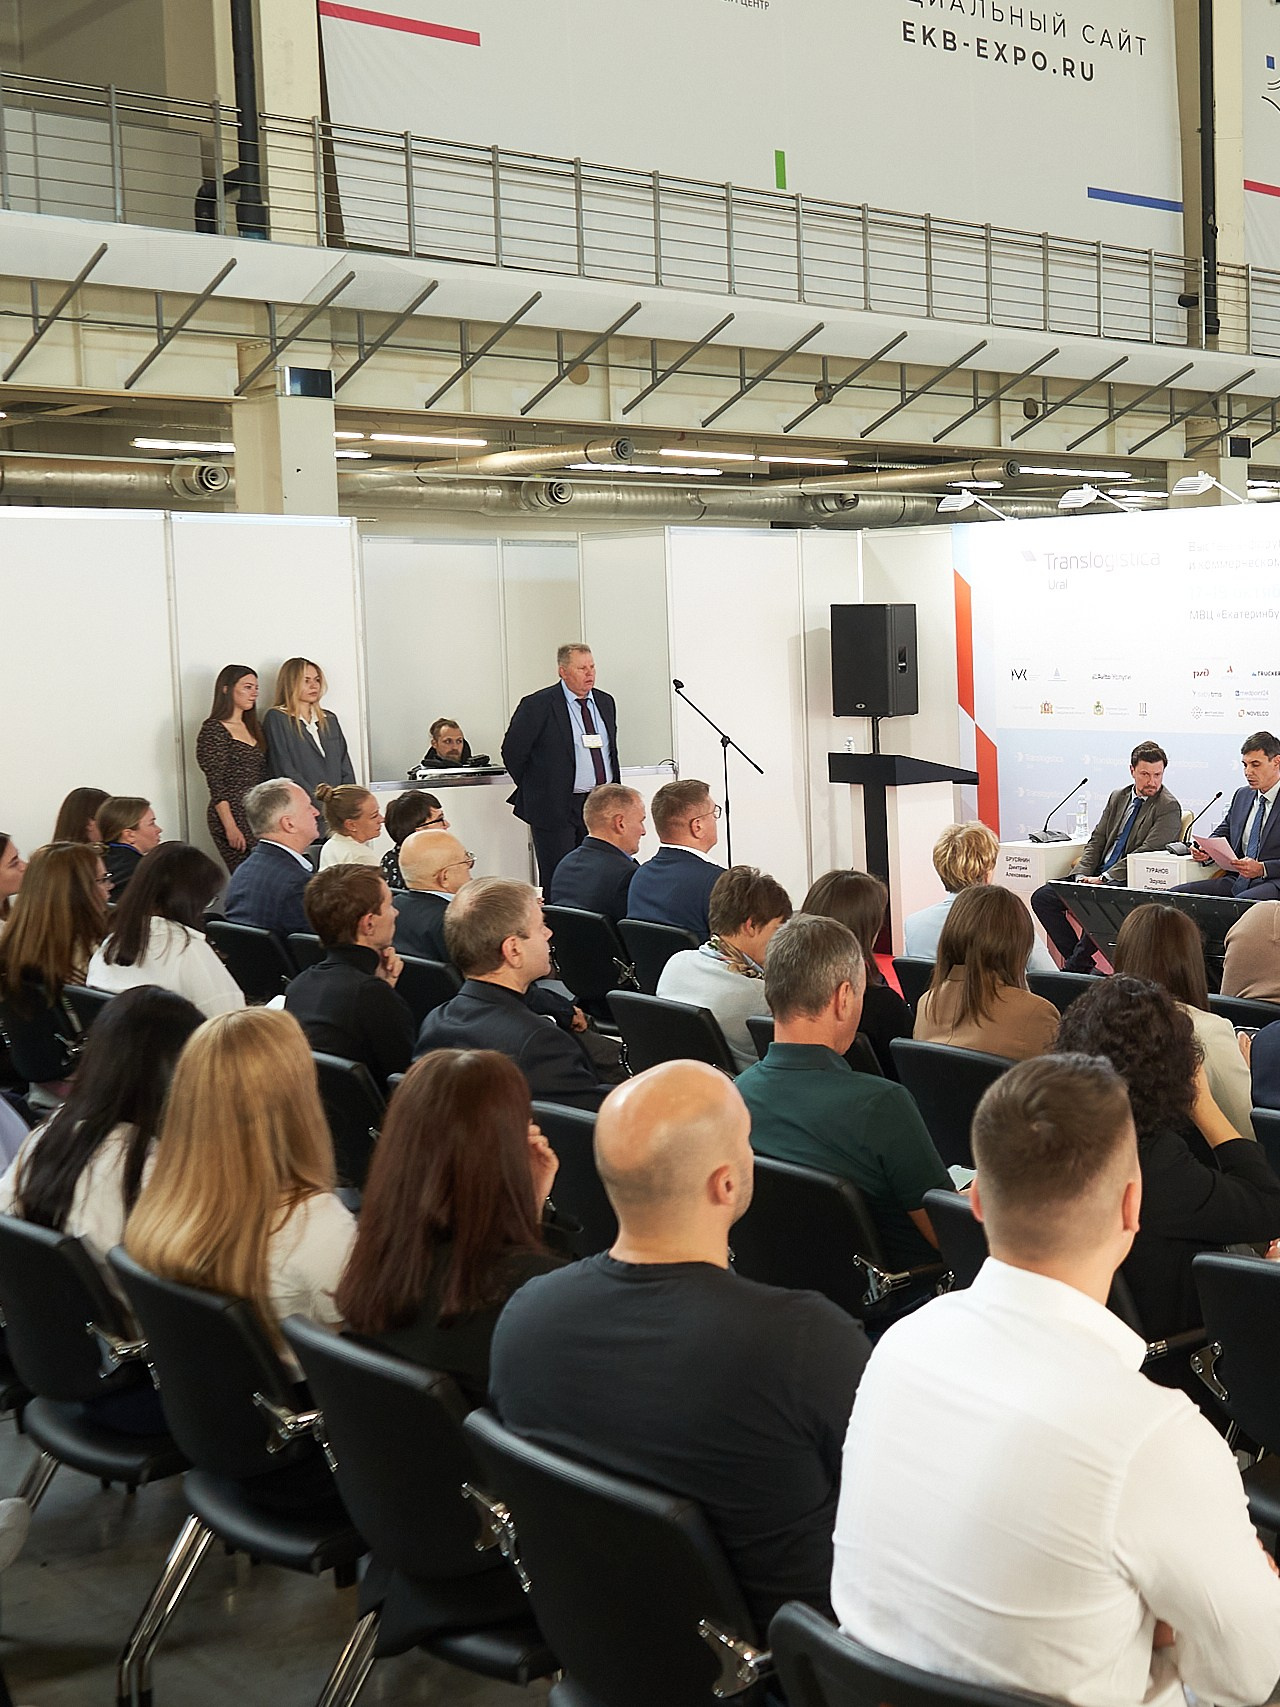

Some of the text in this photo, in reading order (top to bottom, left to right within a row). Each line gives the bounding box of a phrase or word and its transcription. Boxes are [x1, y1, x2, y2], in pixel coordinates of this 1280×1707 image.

[1081, 24, 1147, 56] САЙТ
[902, 20, 1095, 82] EKB-EXPO.RU
[1043, 551, 1161, 572] Translogistica
[1048, 578, 1068, 590] Ural
[1190, 609, 1214, 620] МВЦ
